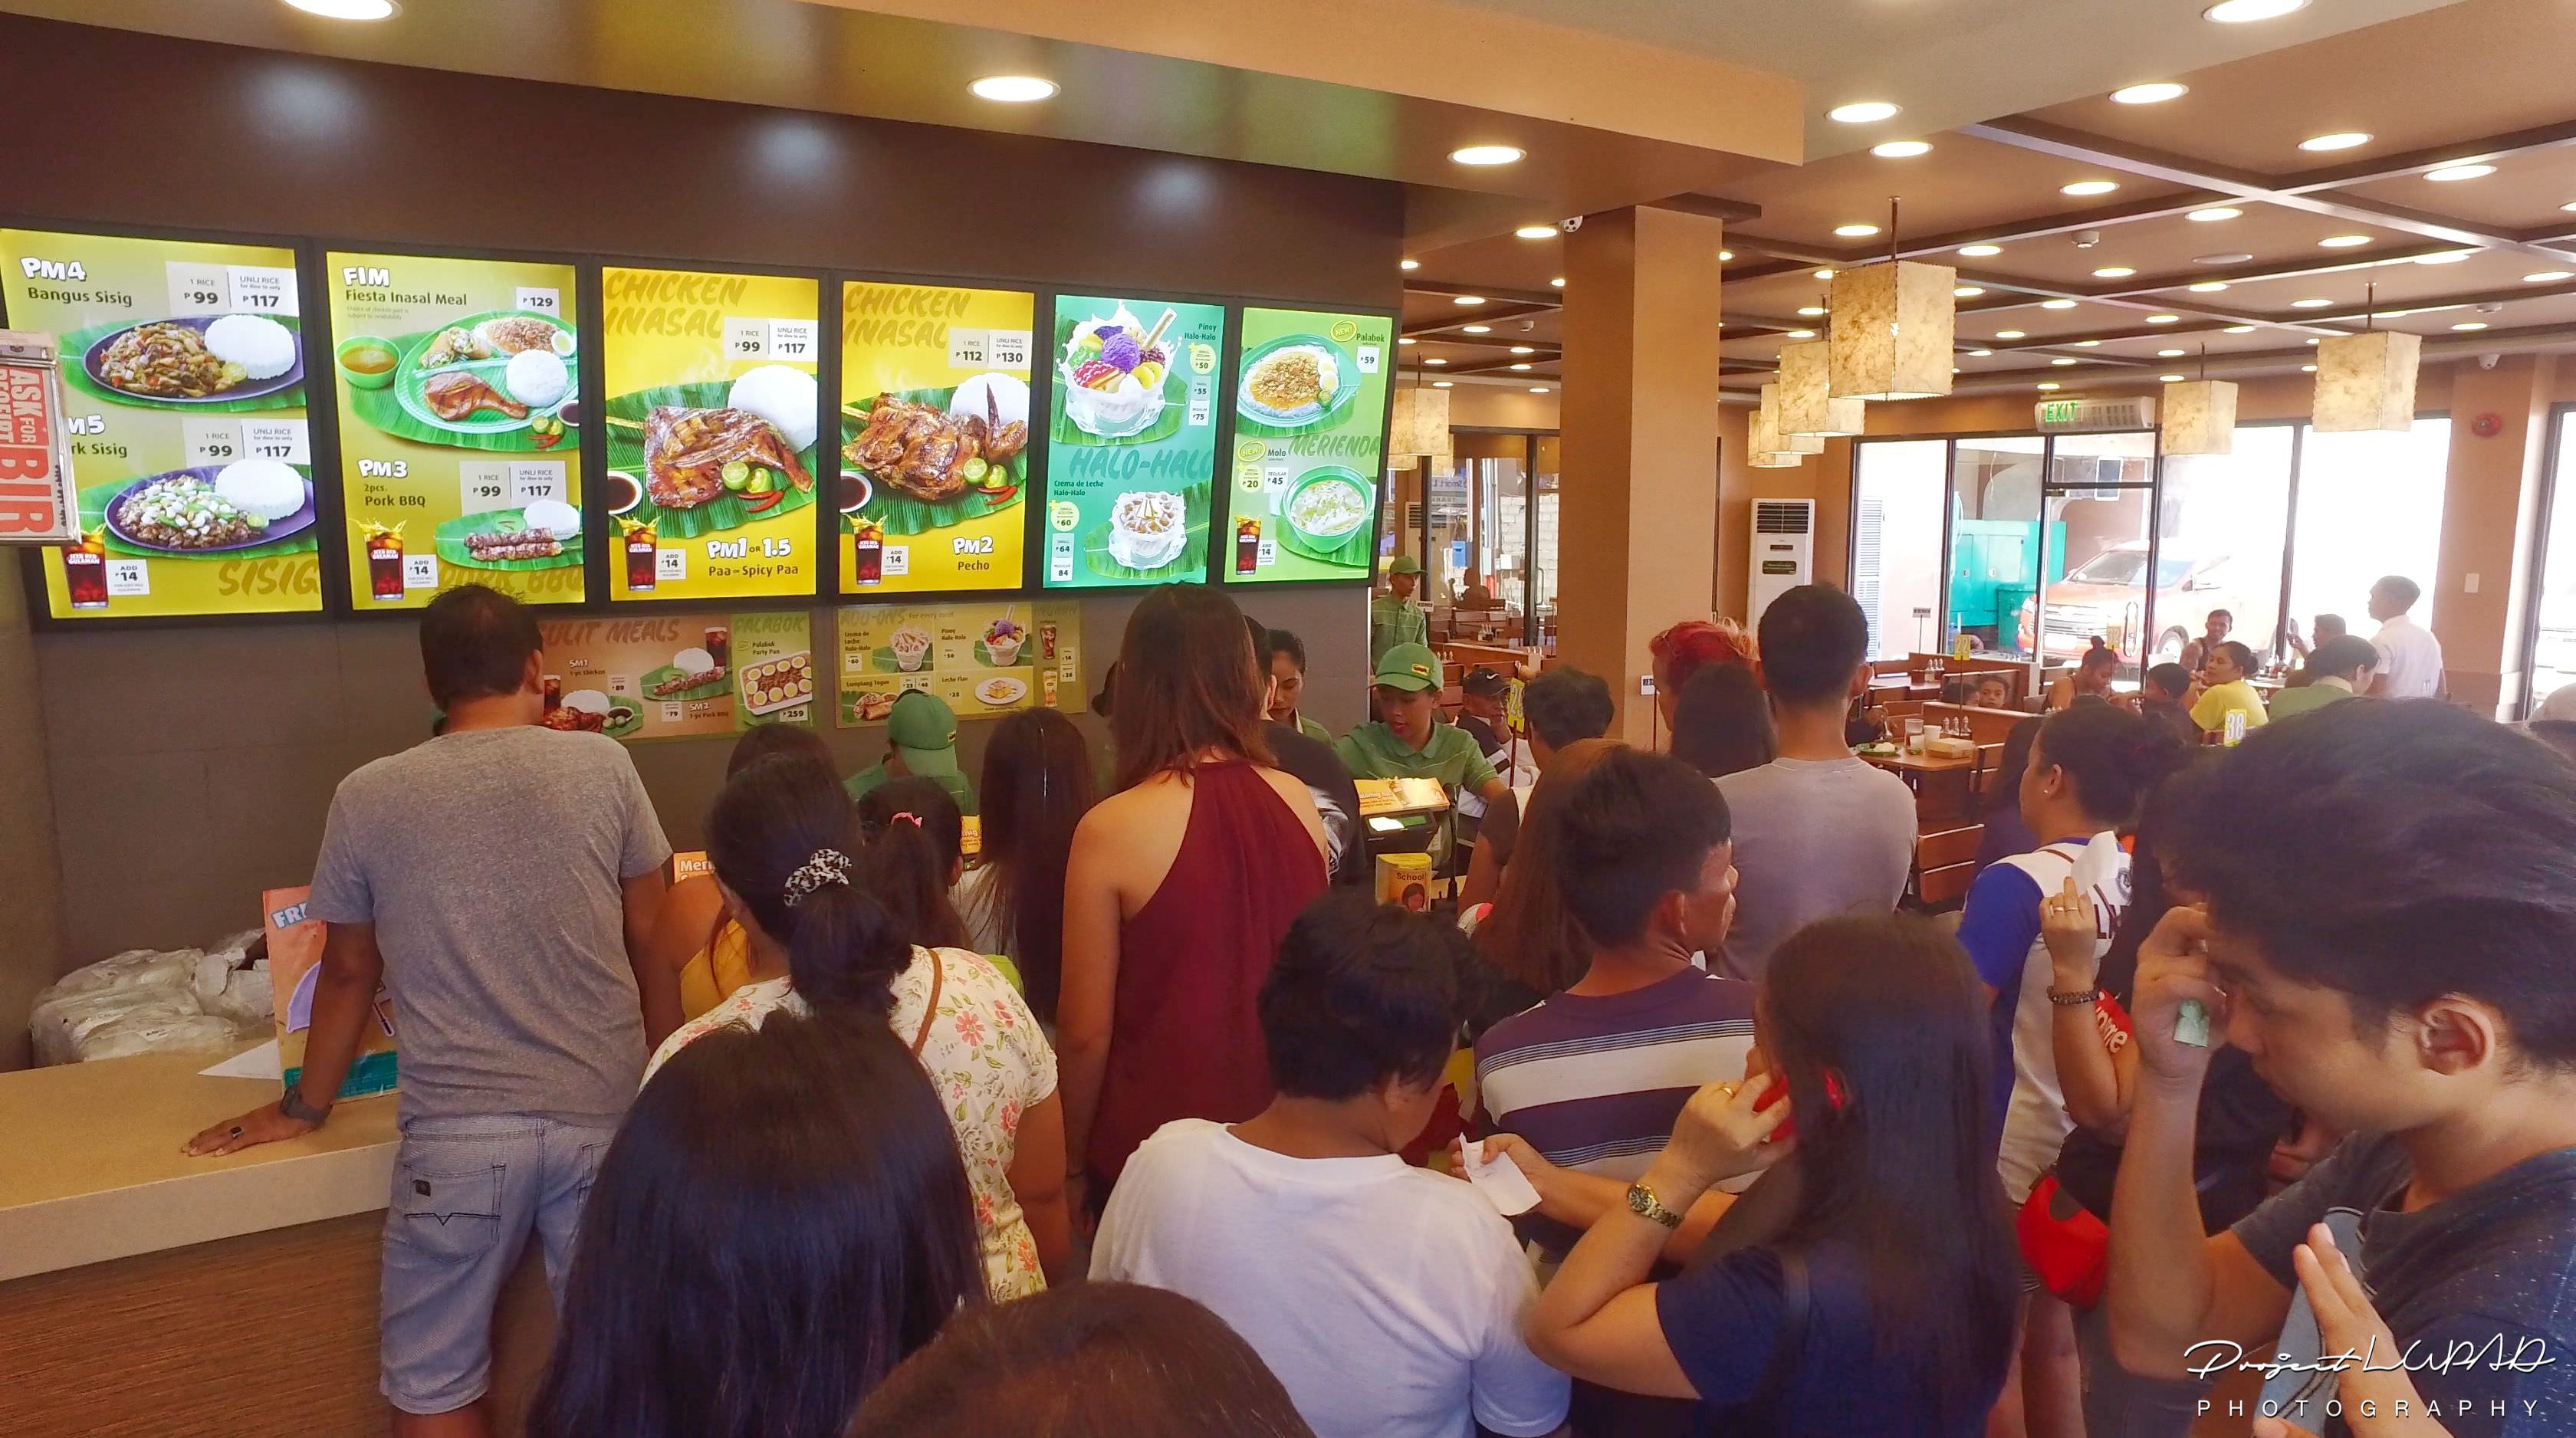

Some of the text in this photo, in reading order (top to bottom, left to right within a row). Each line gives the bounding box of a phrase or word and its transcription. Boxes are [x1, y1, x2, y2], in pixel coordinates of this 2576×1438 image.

[20, 257, 87, 281] PM4
[343, 266, 390, 287] FIM
[239, 275, 280, 284] UNLI RICE
[605, 271, 748, 307] CHICKEN
[28, 287, 133, 307] Bangus Sisig
[345, 290, 467, 305] Fiesta Inasal Meal
[844, 285, 971, 319] CHICKEN
[604, 307, 722, 339] INASAL
[1198, 323, 1217, 333] Pinoy
[843, 319, 948, 350] INASAL
[1356, 333, 1385, 343] Palabok
[9, 369, 42, 443] ASK FOR
[2045, 402, 2078, 422] EXIT
[68, 414, 106, 436] M5
[71, 442, 127, 458] rk Sisig
[1267, 448, 1286, 457] Molo
[1288, 435, 1379, 458] MERIENDA
[357, 459, 409, 478] PM3
[0, 447, 54, 533] BIR
[365, 496, 426, 507] Pork BBQ
[706, 537, 748, 559] PM1
[762, 538, 791, 558] 1.5
[952, 537, 994, 555] PM2
[708, 566, 731, 576] Paa
[742, 566, 773, 577] Spicy
[777, 563, 798, 575] Paa
[958, 560, 990, 571] Pecho
[218, 560, 320, 597] SISIG
[606, 619, 681, 644] MEALS
[734, 617, 804, 633] PALABOK
[1956, 637, 1968, 653] 22
[569, 660, 588, 668] SM1
[690, 703, 710, 711] SM2
[2226, 712, 2245, 740] 38
